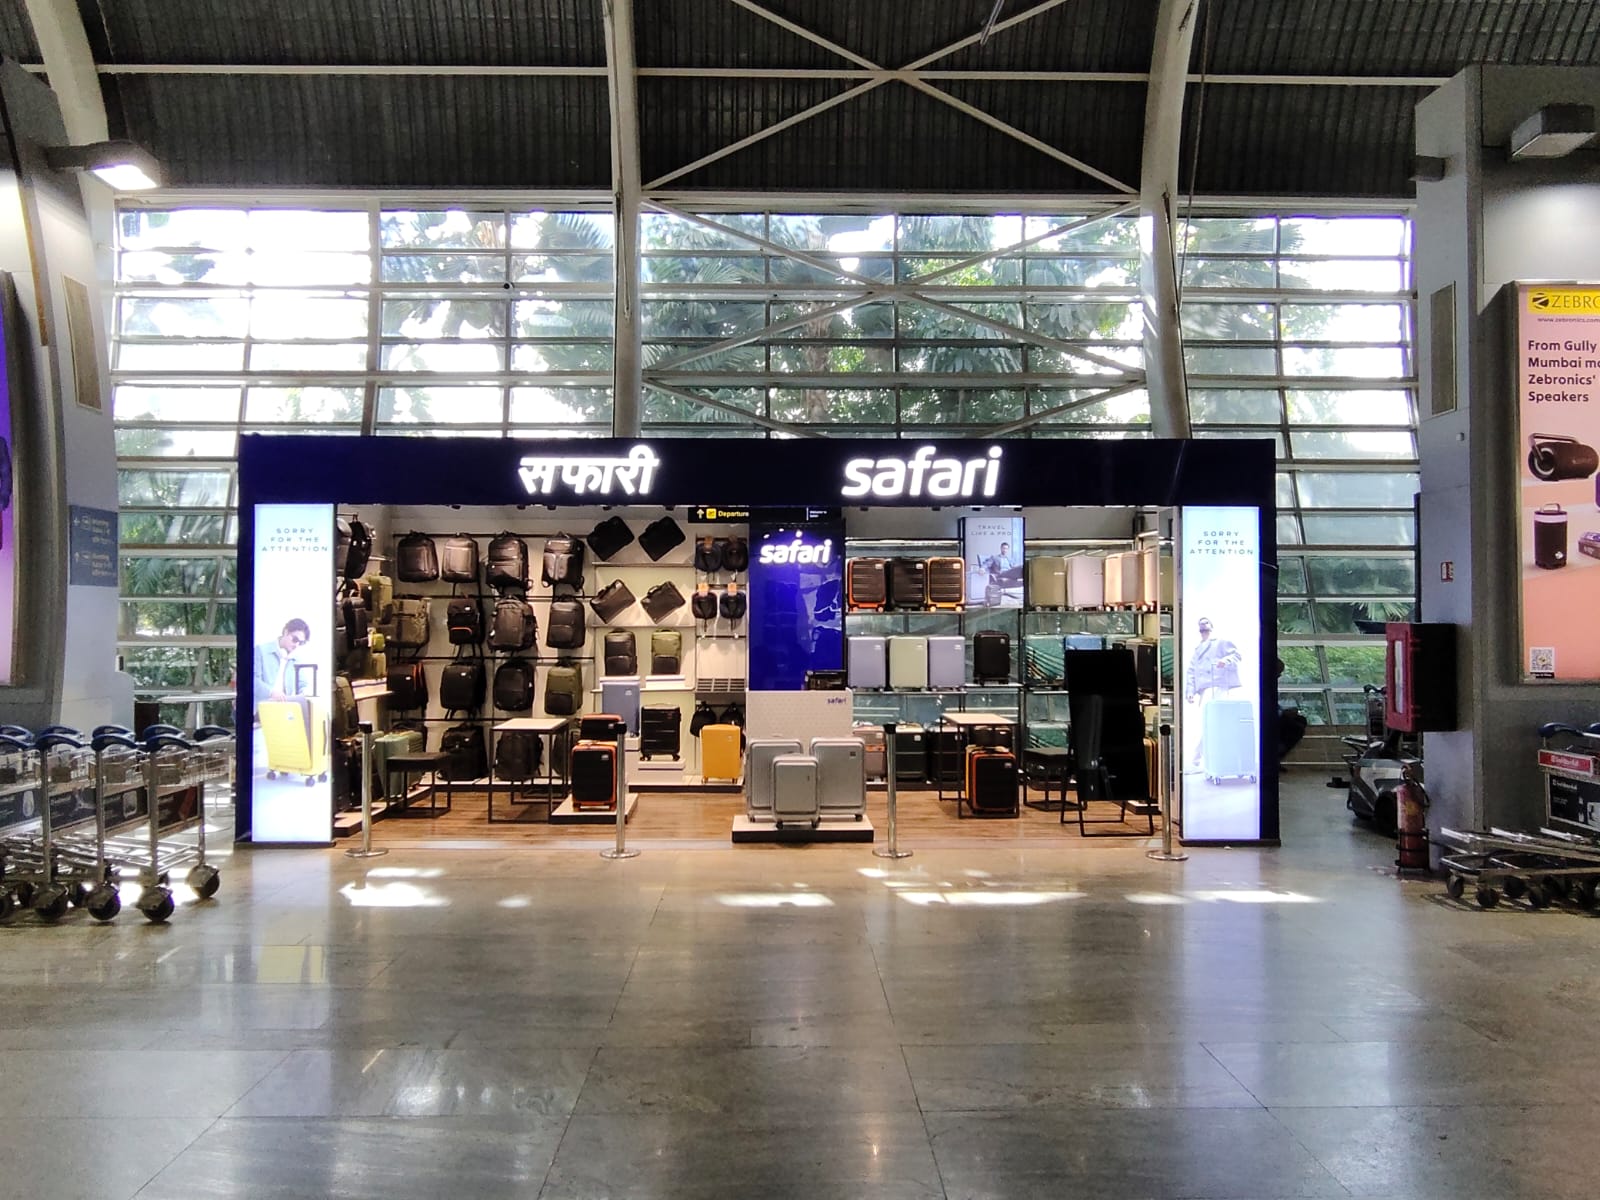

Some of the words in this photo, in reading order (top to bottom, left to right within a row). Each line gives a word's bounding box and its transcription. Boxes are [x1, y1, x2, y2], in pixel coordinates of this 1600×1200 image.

[1528, 340, 1560, 351] From
[1564, 340, 1597, 353] Gully
[1528, 357, 1581, 368] Mumbai
[1528, 373, 1596, 385] Zebronics'
[1528, 391, 1589, 403] Speakers
[518, 445, 660, 494] सफारी
[841, 446, 1003, 496] safari
[759, 538, 833, 564] safari
